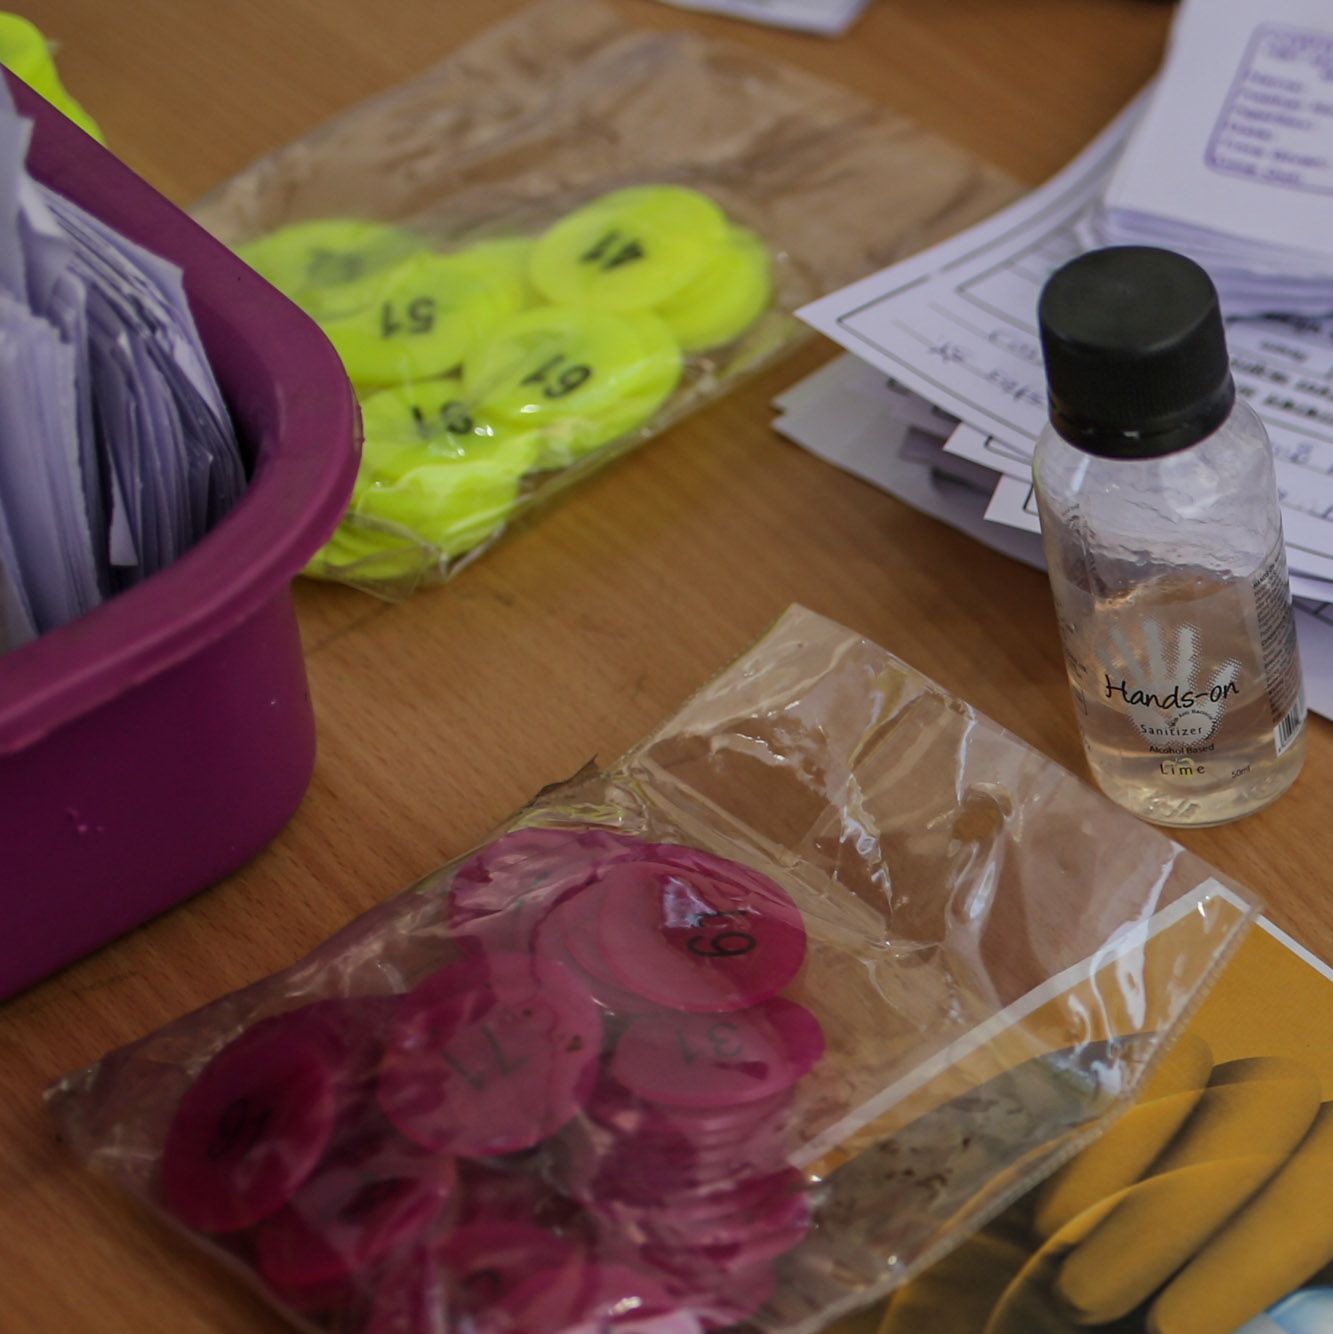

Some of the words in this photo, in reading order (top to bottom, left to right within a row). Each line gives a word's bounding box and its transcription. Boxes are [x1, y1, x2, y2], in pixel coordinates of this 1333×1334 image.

[381, 297, 437, 338] 51
[519, 353, 595, 399] 61
[1105, 674, 1241, 709] Hands-on
[1140, 723, 1203, 736] Sanitizer
[1149, 744, 1184, 755] Alcohol
[1186, 743, 1214, 753] Based
[1160, 764, 1205, 777] Lime
[671, 1021, 744, 1066] 31
